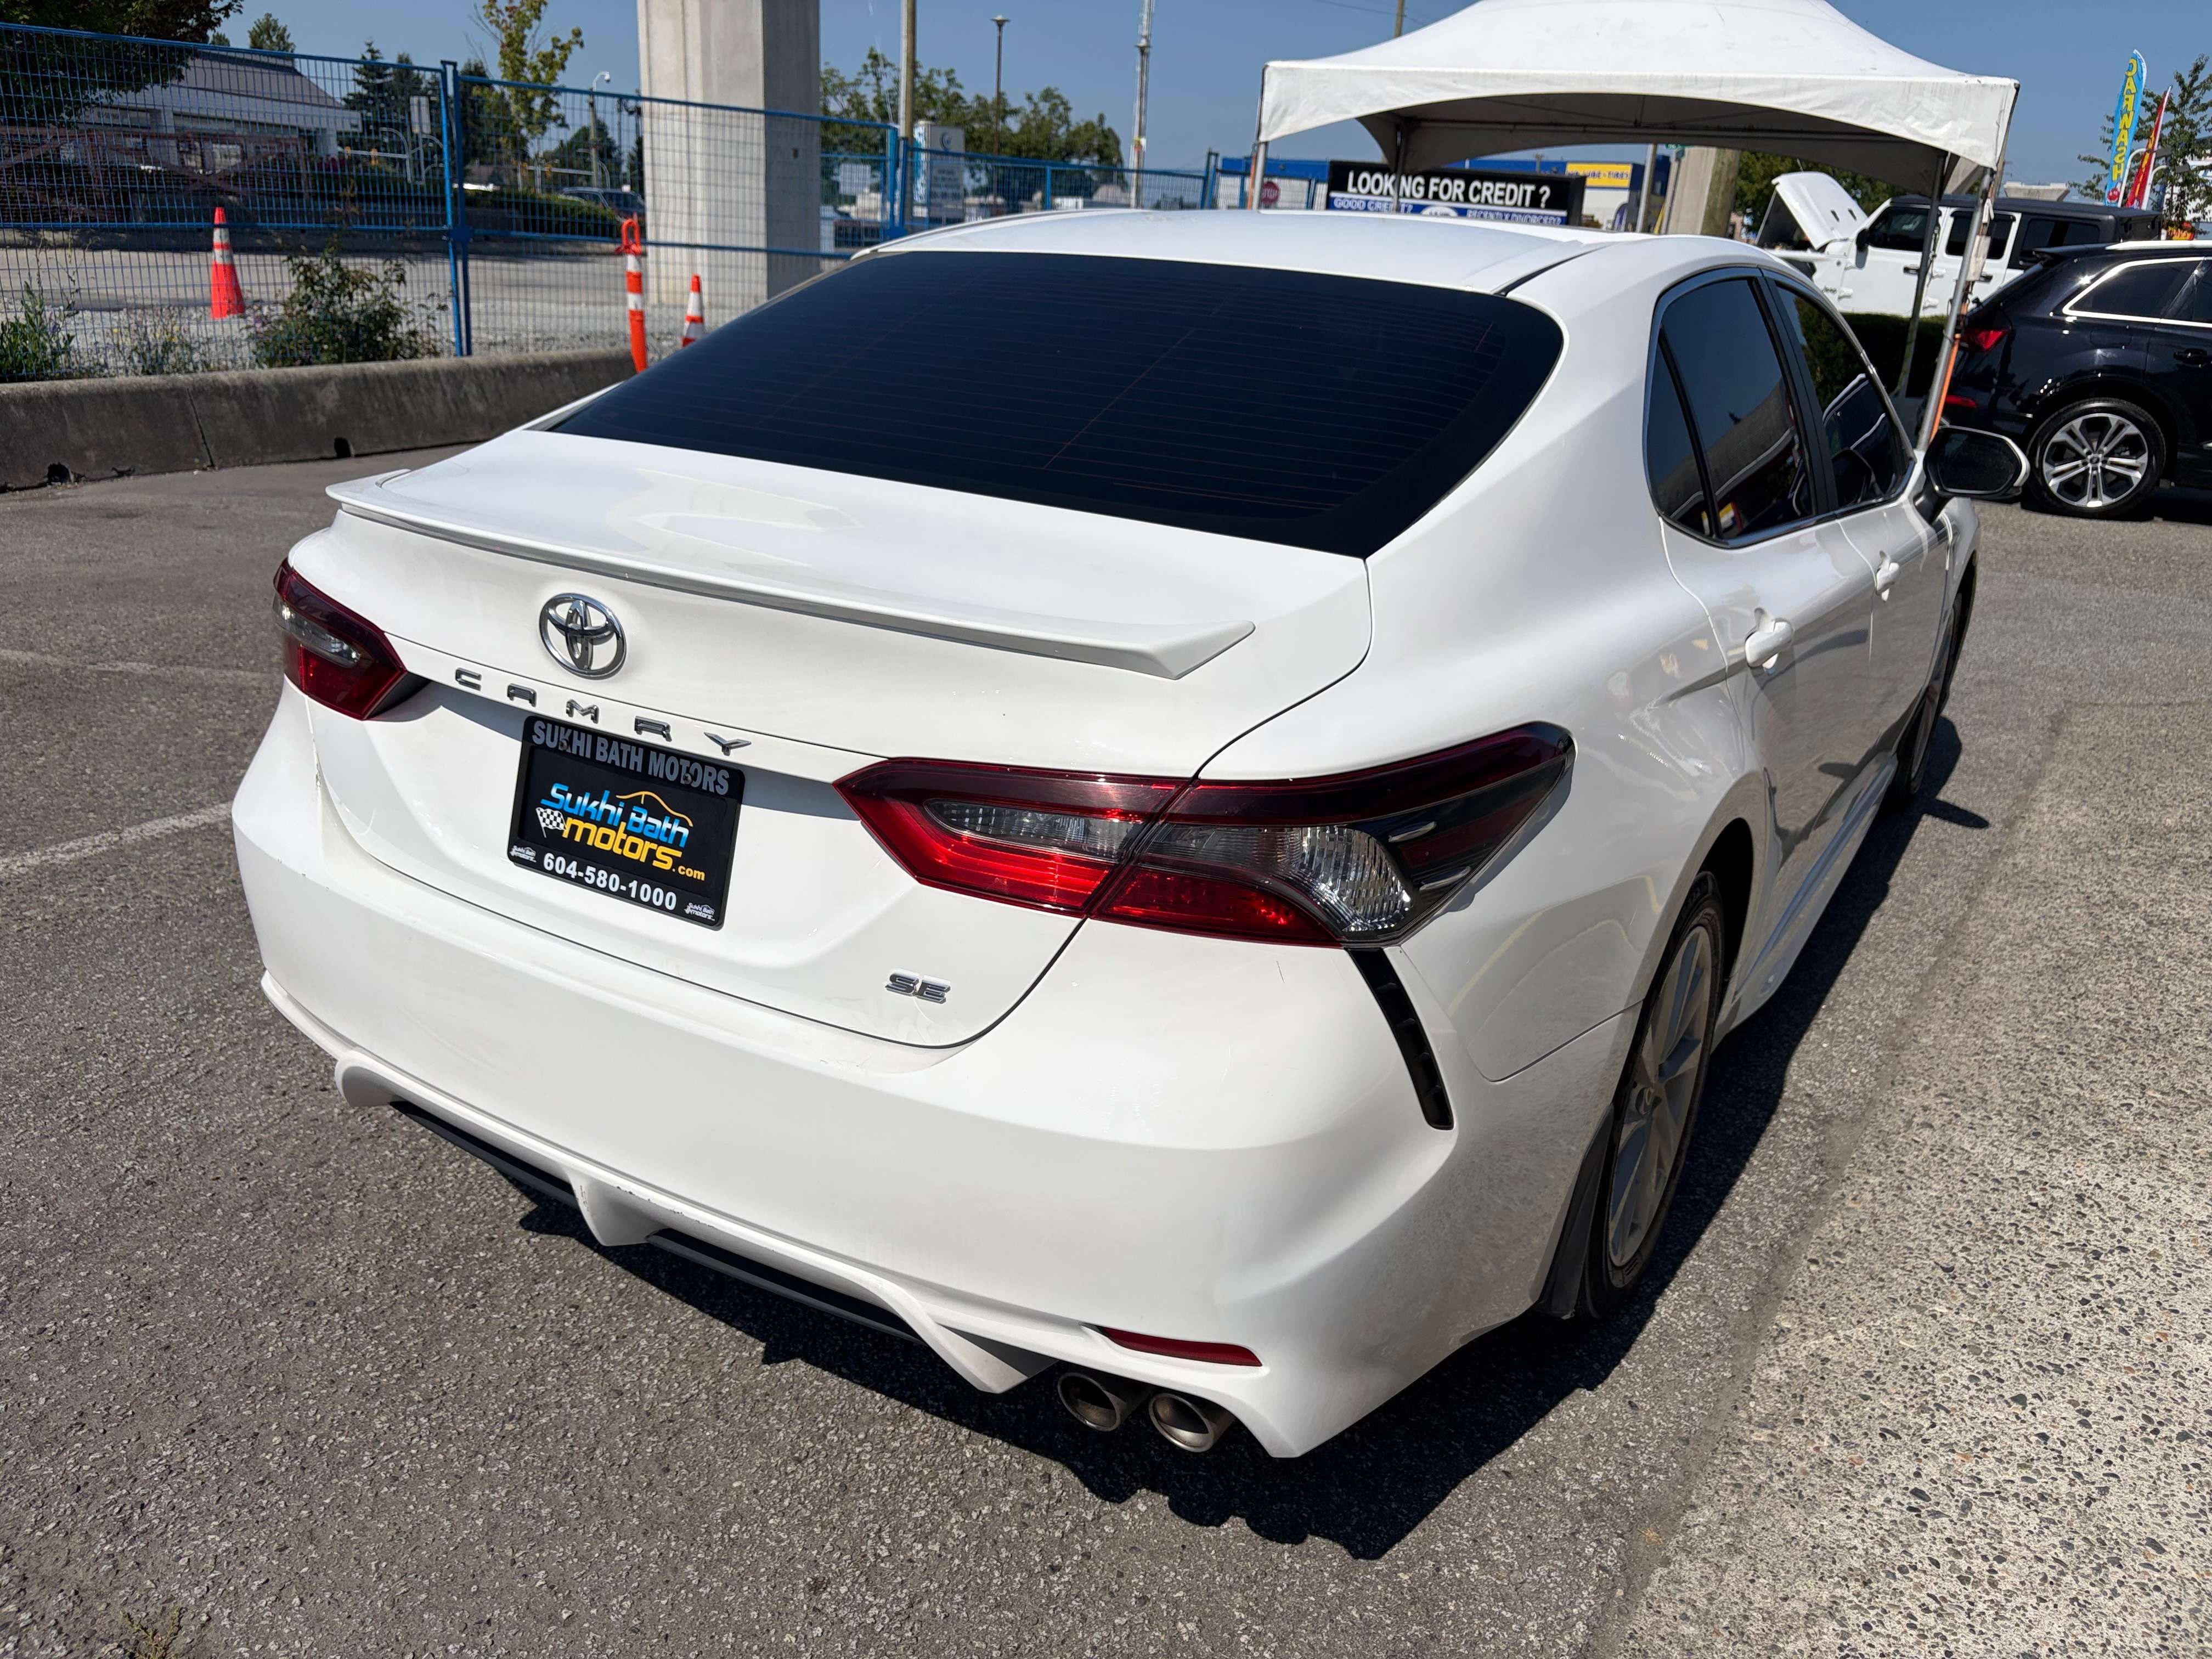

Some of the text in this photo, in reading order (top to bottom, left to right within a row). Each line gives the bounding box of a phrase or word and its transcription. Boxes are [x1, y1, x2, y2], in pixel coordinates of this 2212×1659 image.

[1334, 198, 1366, 211] GOOD
[1346, 170, 1425, 199] LOOKNG
[1427, 176, 1465, 202] FOR
[1468, 180, 1536, 207] CREDIT
[455, 667, 752, 755] CAMRY
[532, 720, 730, 795] SUKHI BATH MOTORS
[540, 782, 689, 848] Sukhi Bath
[543, 853, 677, 911] 604-580-1000
[884, 973, 951, 1005] SE
